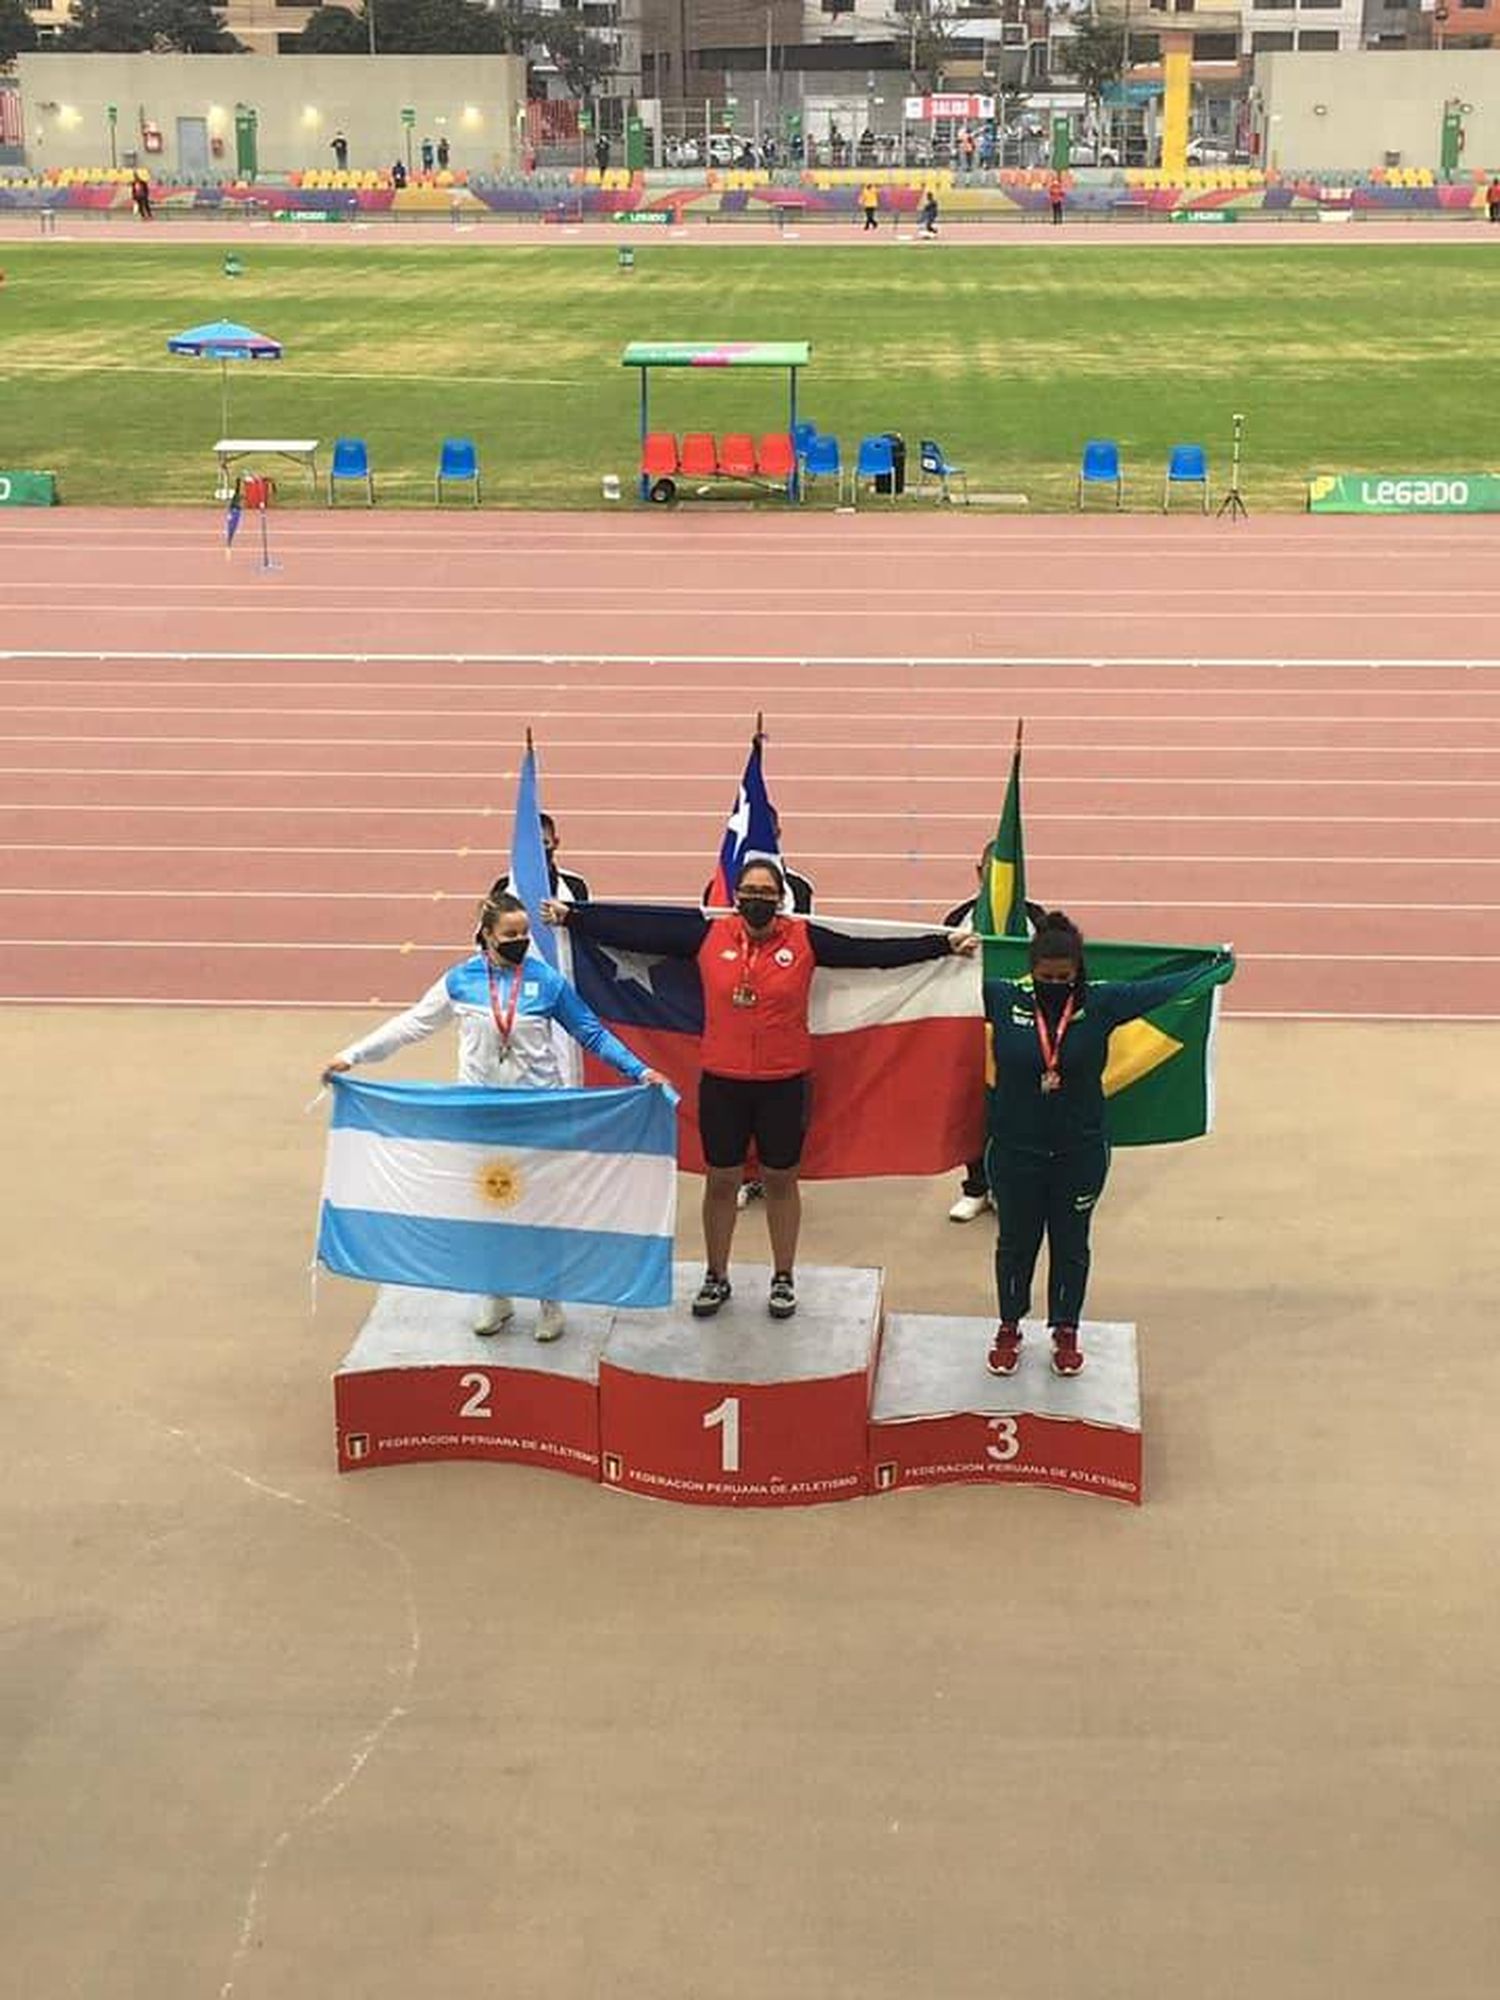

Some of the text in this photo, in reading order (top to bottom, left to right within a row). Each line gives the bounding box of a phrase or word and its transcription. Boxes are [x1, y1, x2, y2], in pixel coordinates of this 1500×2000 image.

[458, 1372, 493, 1418] 2
[462, 1434, 520, 1447] PERUANA
[521, 1440, 538, 1450] DE
[703, 1397, 742, 1472] 1
[985, 1416, 1020, 1461] 3
[706, 1483, 768, 1494] PERUANA
[770, 1484, 788, 1495] DE
[790, 1476, 858, 1493] ATLETISMO
[987, 1463, 1048, 1474] PERUANA
[1050, 1467, 1067, 1478] DE
[1069, 1471, 1136, 1493] ATLETISMO
